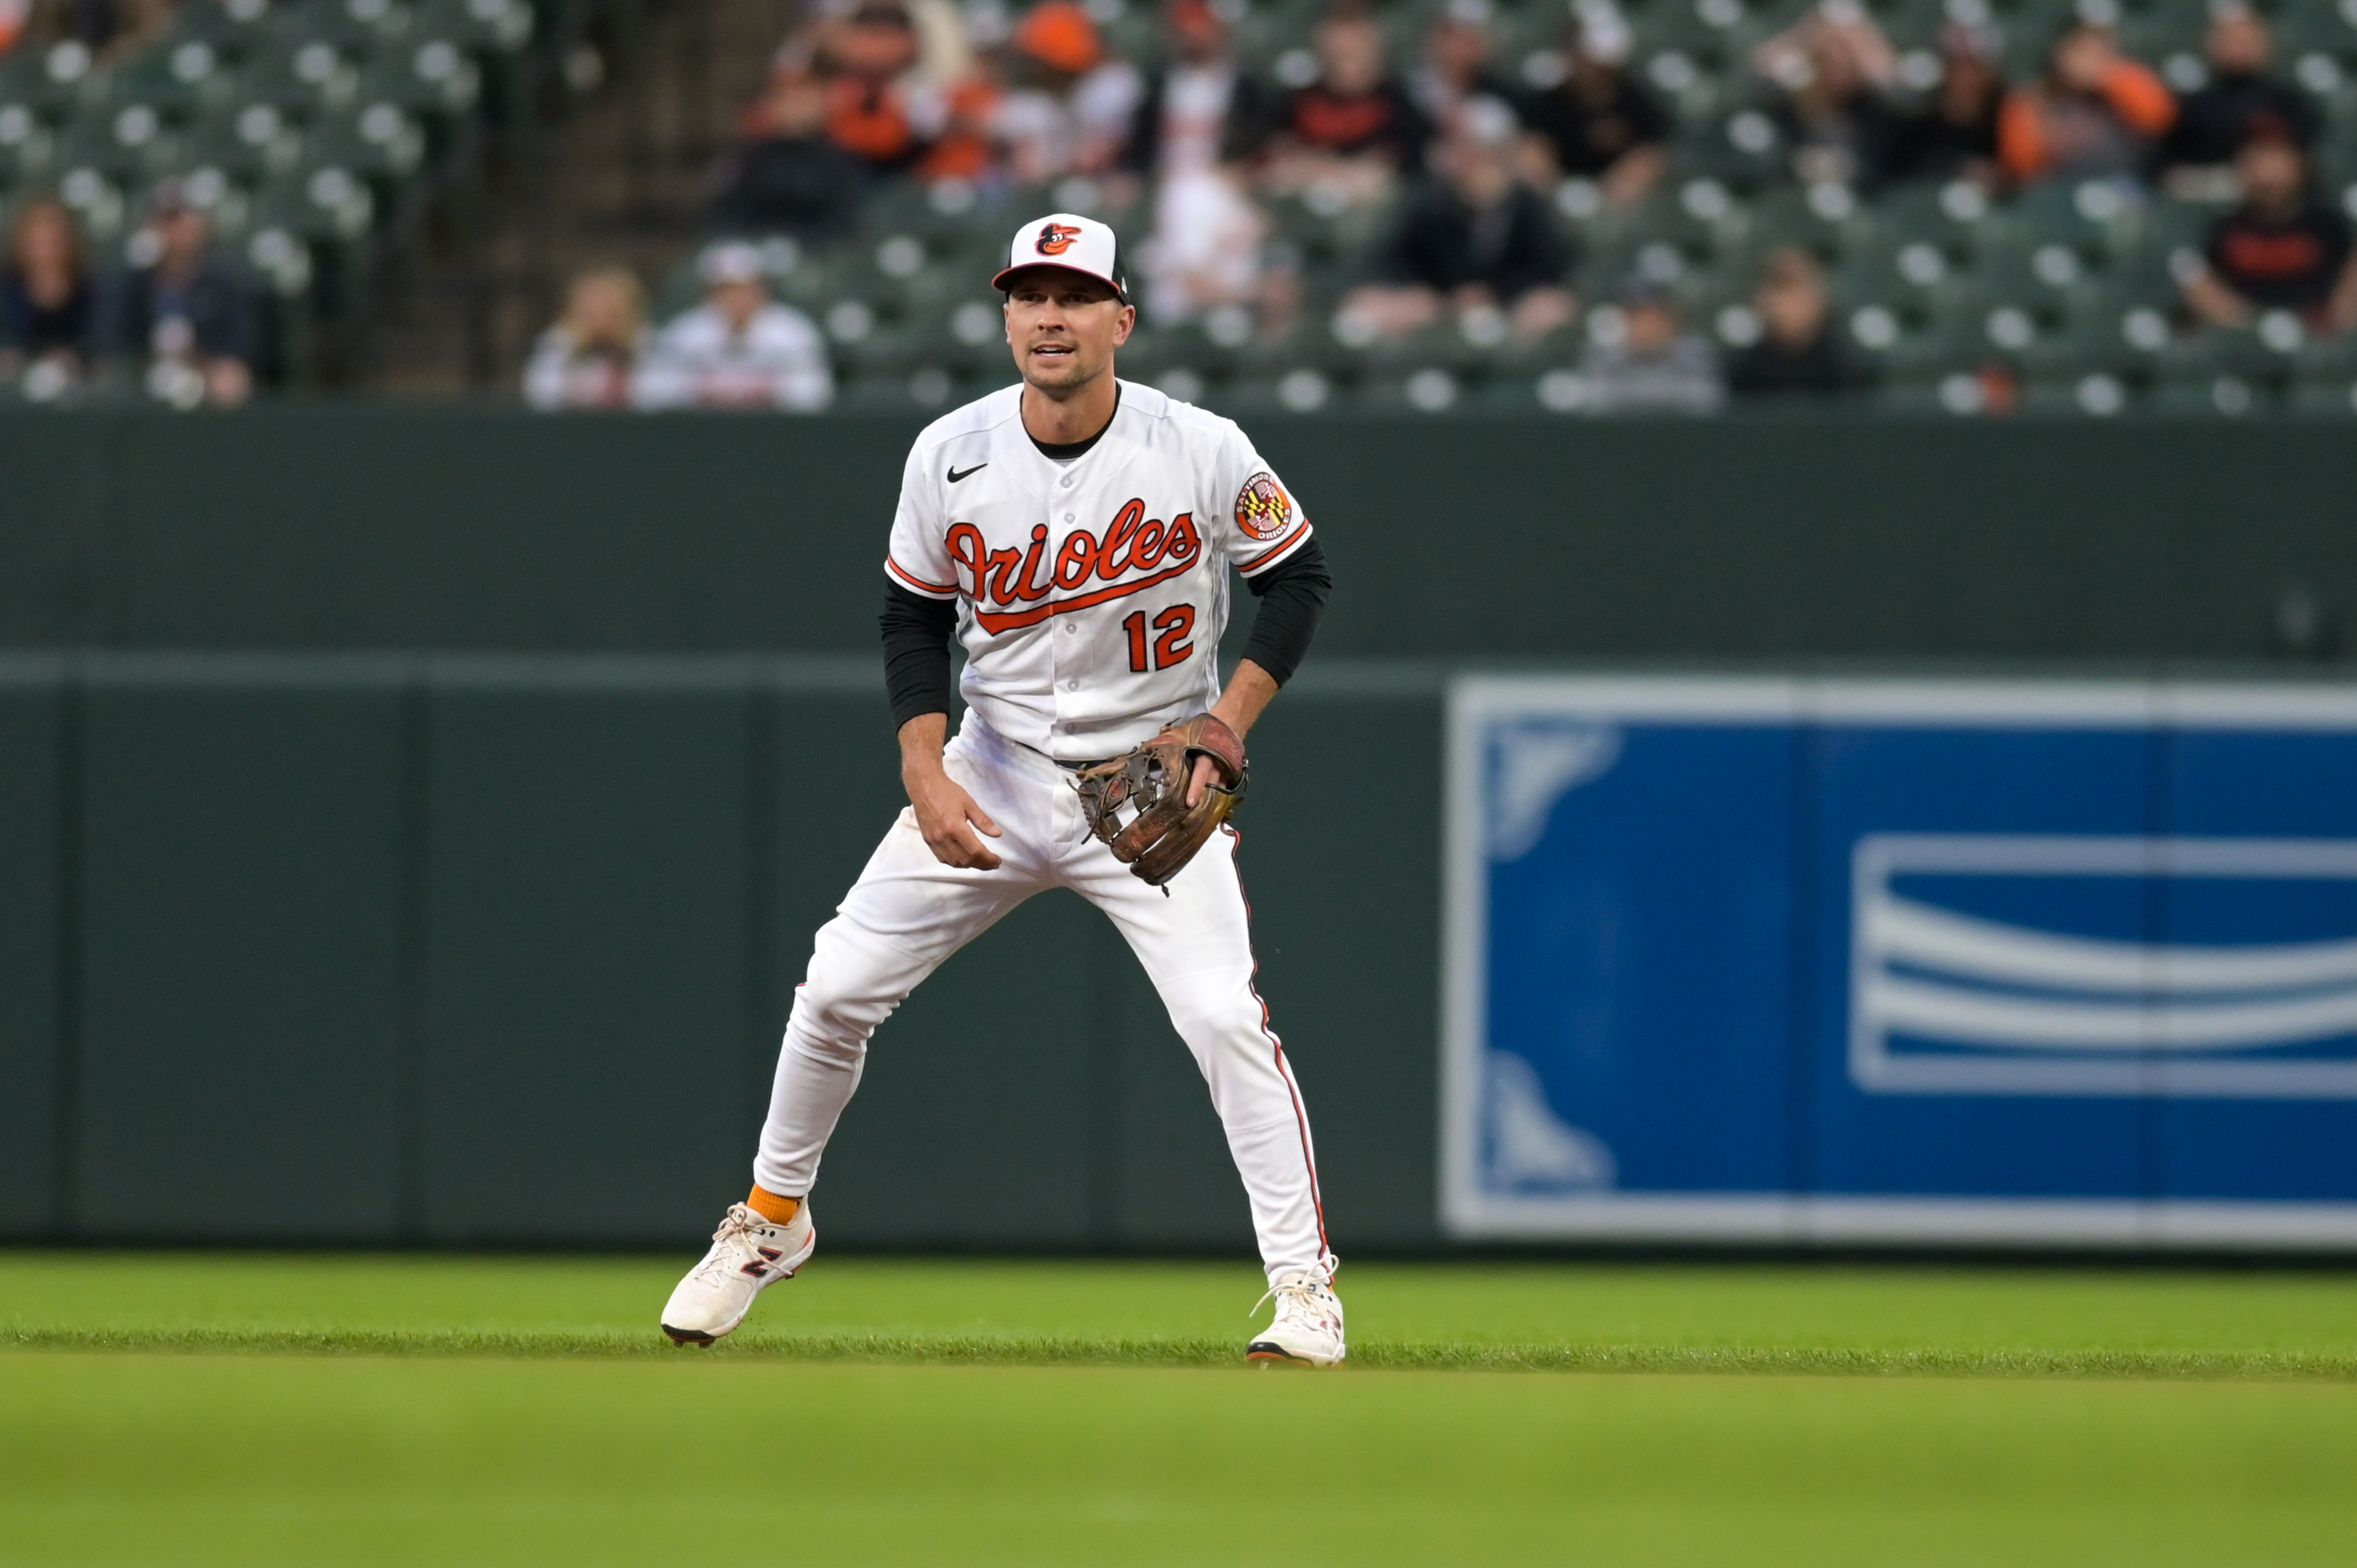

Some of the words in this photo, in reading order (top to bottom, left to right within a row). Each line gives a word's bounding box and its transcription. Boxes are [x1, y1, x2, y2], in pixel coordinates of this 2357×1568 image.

[1236, 472, 1275, 514] BALTIMORE
[945, 497, 1202, 606] Orioles
[1257, 508, 1291, 539] ORIOLES
[1122, 603, 1195, 673] 12
